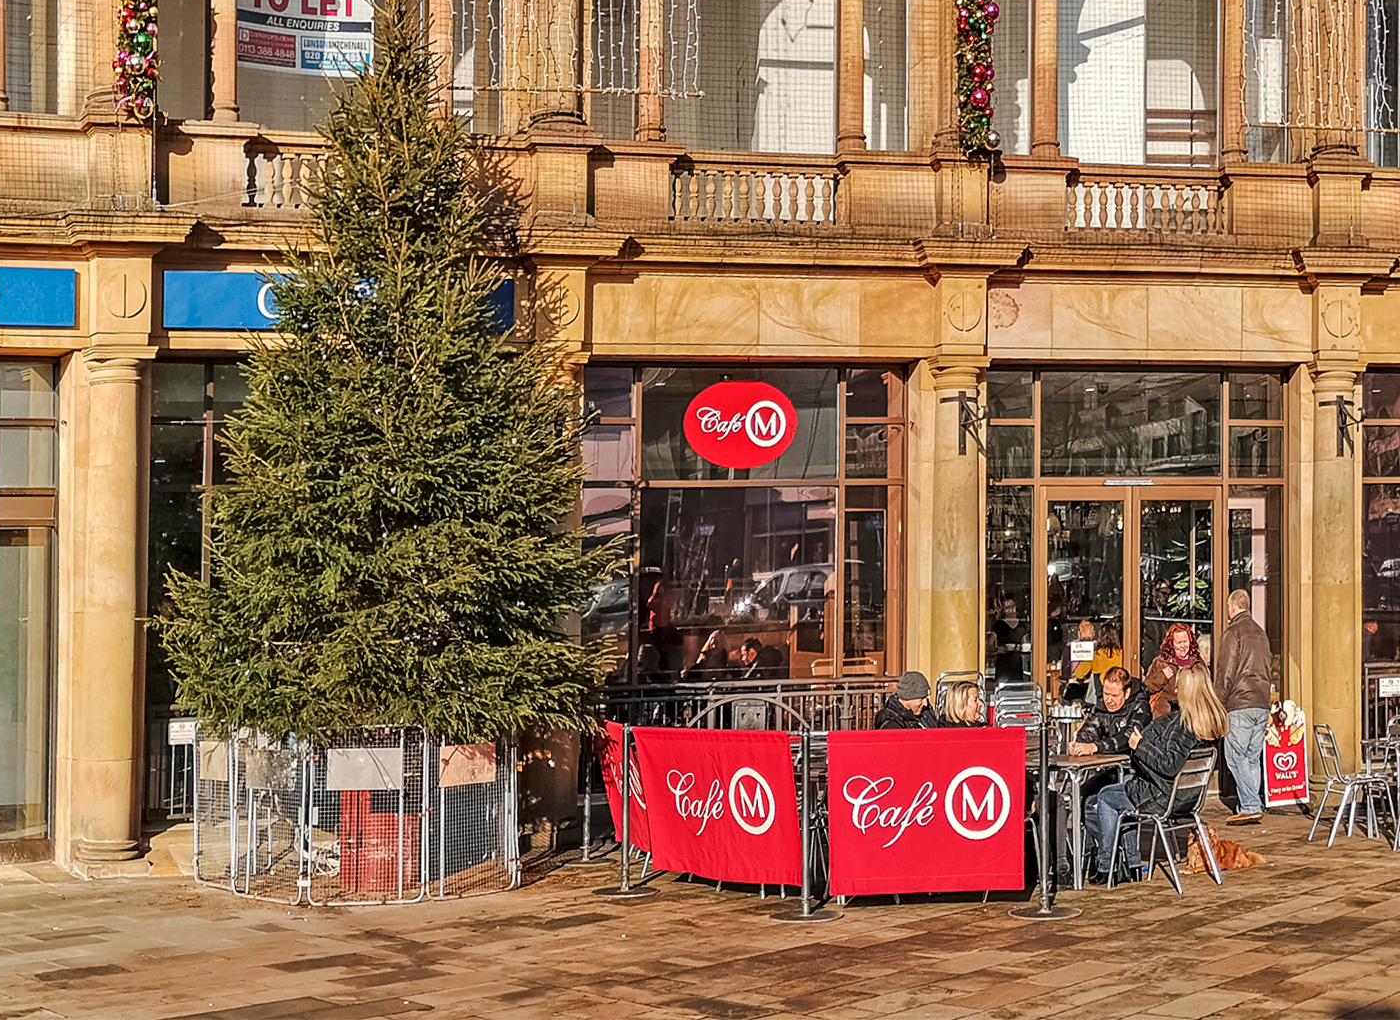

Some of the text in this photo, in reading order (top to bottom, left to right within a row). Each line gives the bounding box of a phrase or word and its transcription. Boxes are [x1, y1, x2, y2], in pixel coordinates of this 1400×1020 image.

[266, 16, 340, 32] ALL ENQUIRIES
[304, 51, 321, 61] 020
[696, 406, 746, 440] Café
[666, 769, 724, 836] Café
[842, 775, 938, 849] Café
